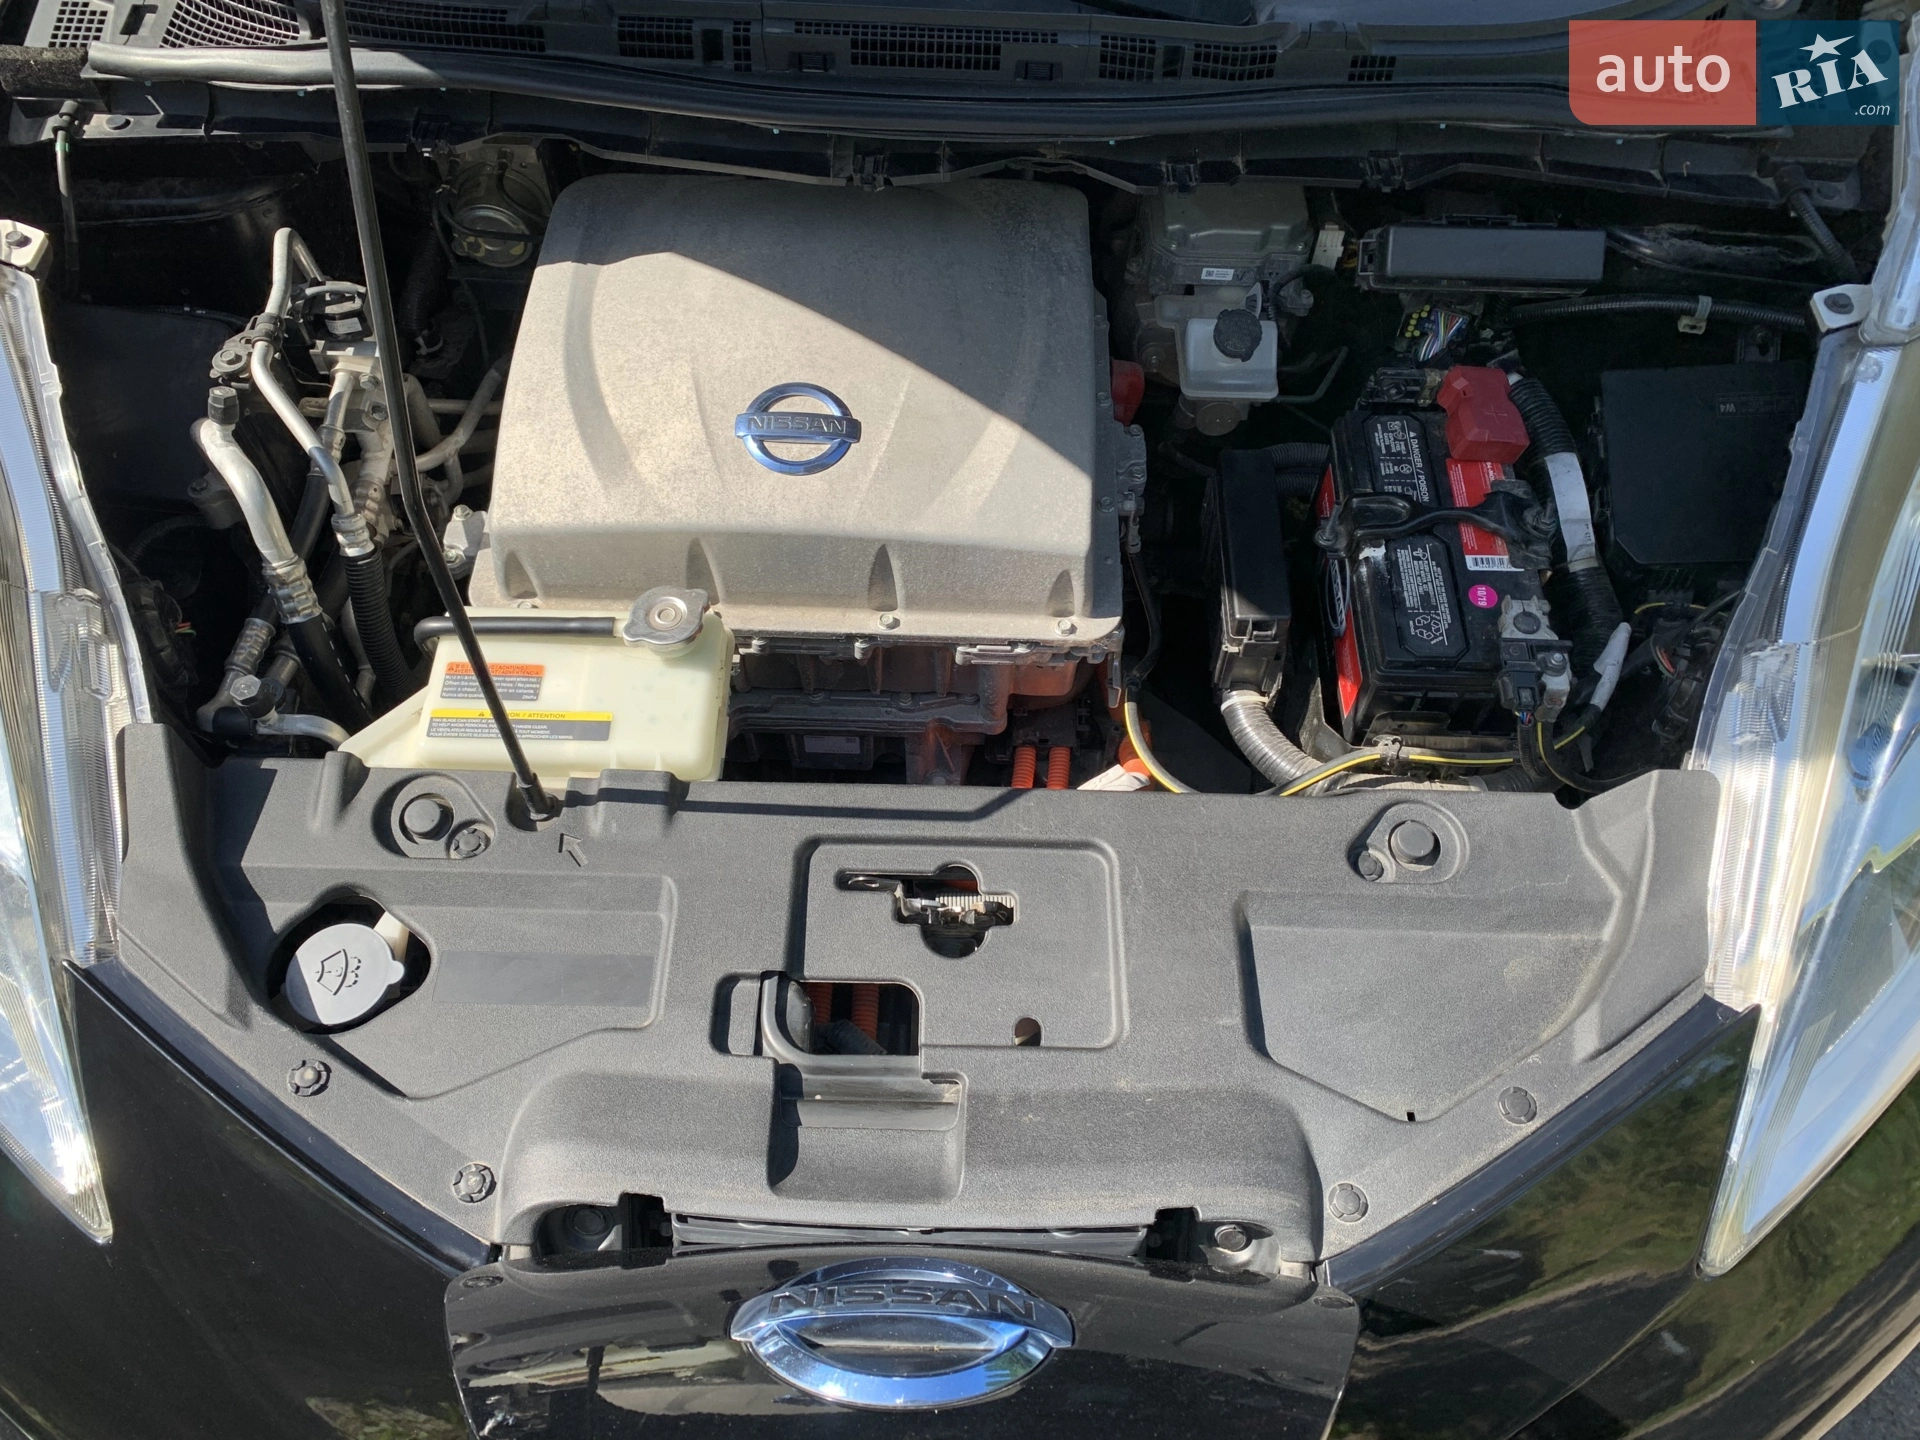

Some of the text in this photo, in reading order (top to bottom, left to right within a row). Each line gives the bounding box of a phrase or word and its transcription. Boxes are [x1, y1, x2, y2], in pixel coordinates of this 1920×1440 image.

[747, 416, 847, 434] NISSAN
[1410, 439, 1422, 467] DANGER
[1418, 475, 1429, 502] POISON
[1477, 587, 1487, 606] 10/19
[768, 1284, 1037, 1322] NISSAN
